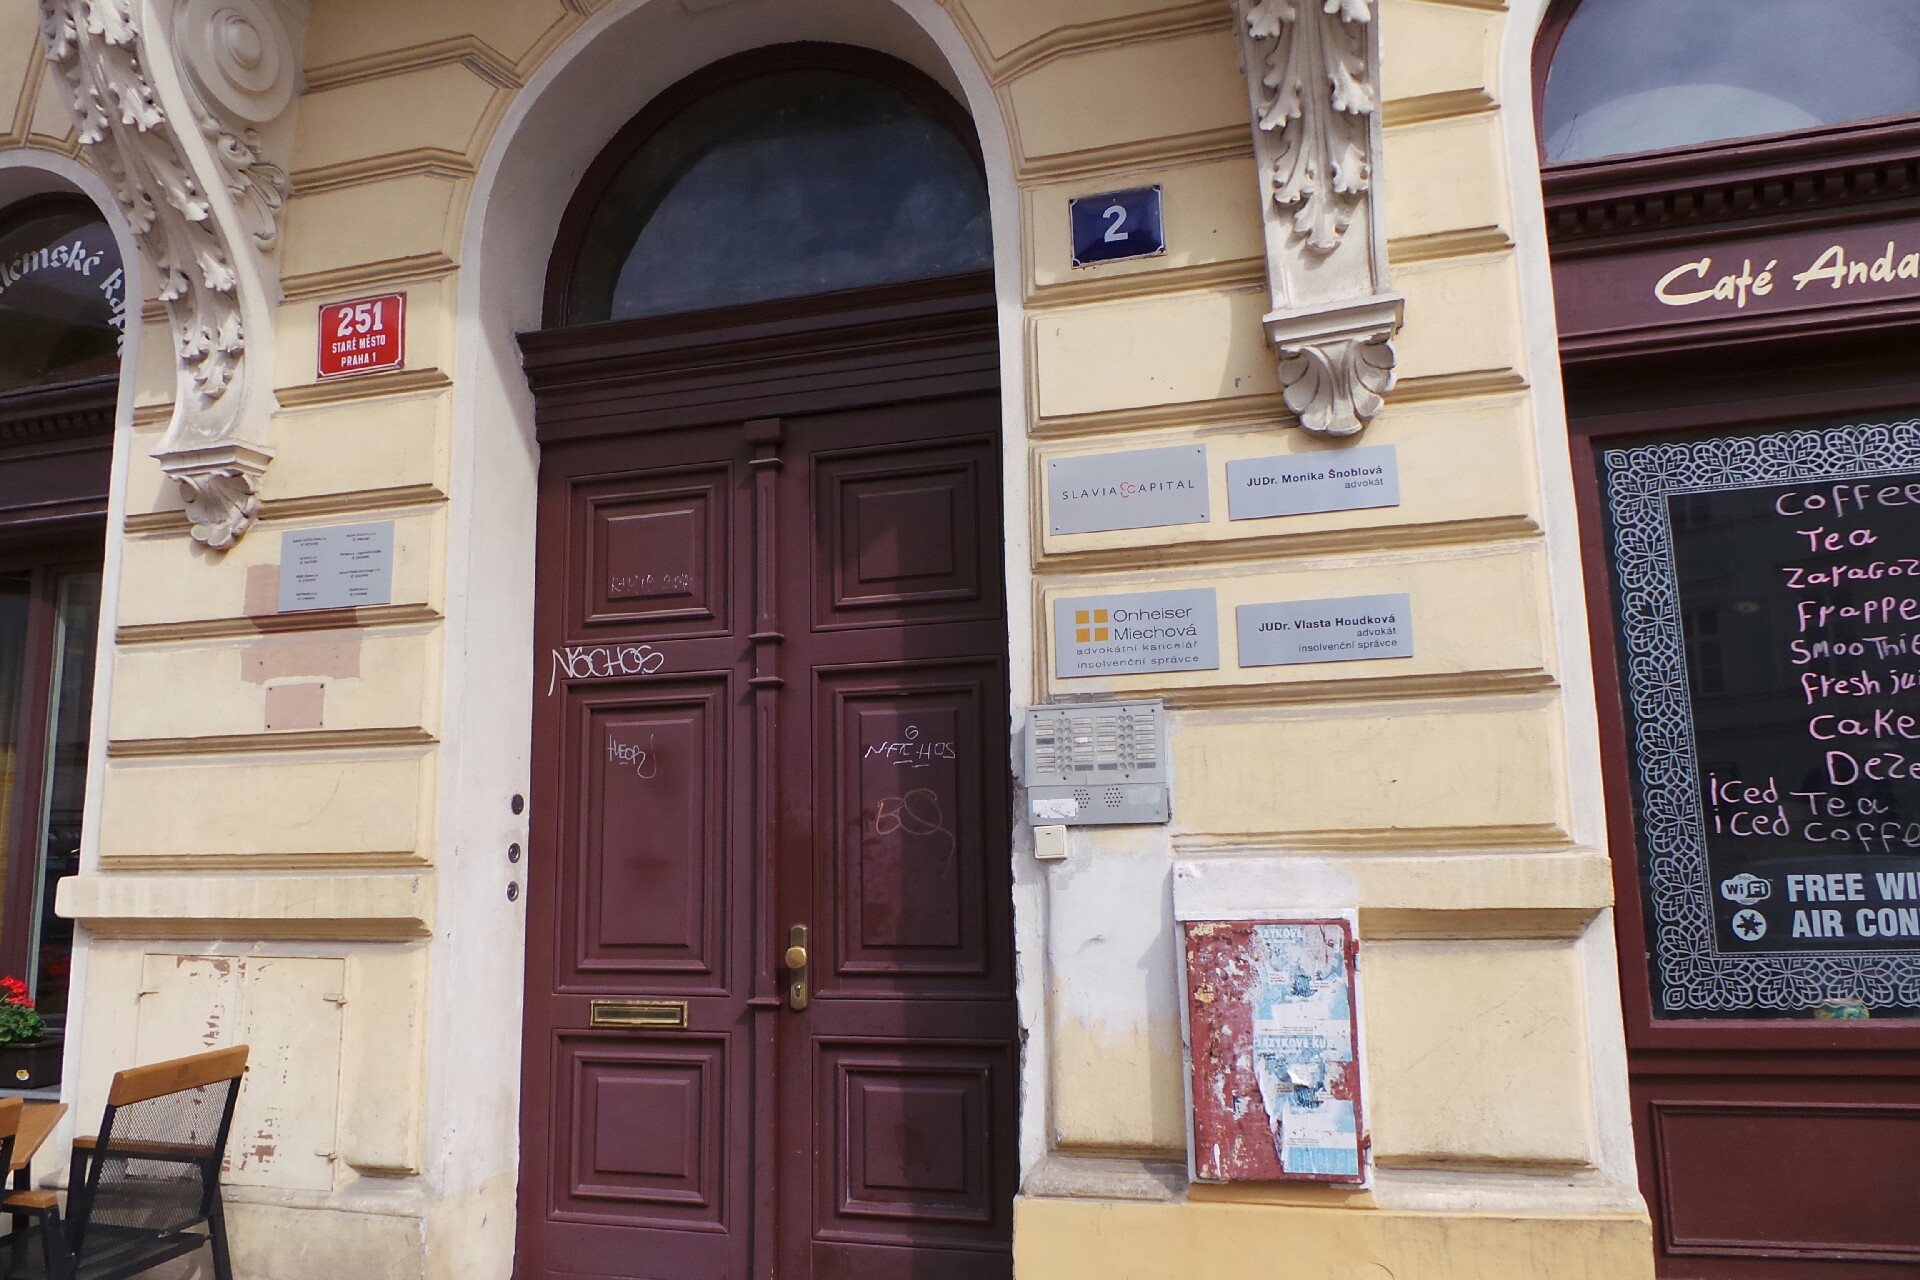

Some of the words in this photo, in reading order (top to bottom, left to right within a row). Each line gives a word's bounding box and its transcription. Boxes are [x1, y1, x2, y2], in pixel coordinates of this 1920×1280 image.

[1102, 205, 1129, 243] 2
[1654, 257, 1778, 308] Café
[1792, 241, 1920, 291] Anda
[337, 301, 383, 337] 251
[332, 337, 357, 354] STARÉ
[359, 334, 386, 349] MĚSTO
[341, 353, 370, 367] PRAHA
[372, 352, 376, 362] 1
[1246, 477, 1278, 487] JUDr.
[1282, 472, 1324, 483] Monika
[1328, 465, 1383, 479] Šnoblová
[1344, 478, 1384, 489] advokát
[1062, 487, 1117, 500] SLAVIA
[1127, 479, 1195, 494] CAPITAL
[1796, 526, 1878, 552] Tea
[1113, 608, 1193, 623] Onheiser
[1258, 622, 1290, 632] JUDr.
[1294, 619, 1331, 629] Vlasta
[1335, 614, 1396, 626] Houdková
[1114, 624, 1197, 641] Miechová
[1356, 627, 1396, 637] advokát
[1076, 644, 1137, 656] advokátní
[1142, 641, 1198, 651] kancelář
[1298, 641, 1355, 652] insolvenční
[1357, 639, 1398, 650] správce
[1077, 657, 1146, 669] insolvenční
[1151, 655, 1199, 666] správce
[1789, 792, 1889, 817] Tea
[1787, 873, 1866, 902] FREE
[1874, 872, 1920, 900] WI
[1792, 909, 1845, 938] AIR
